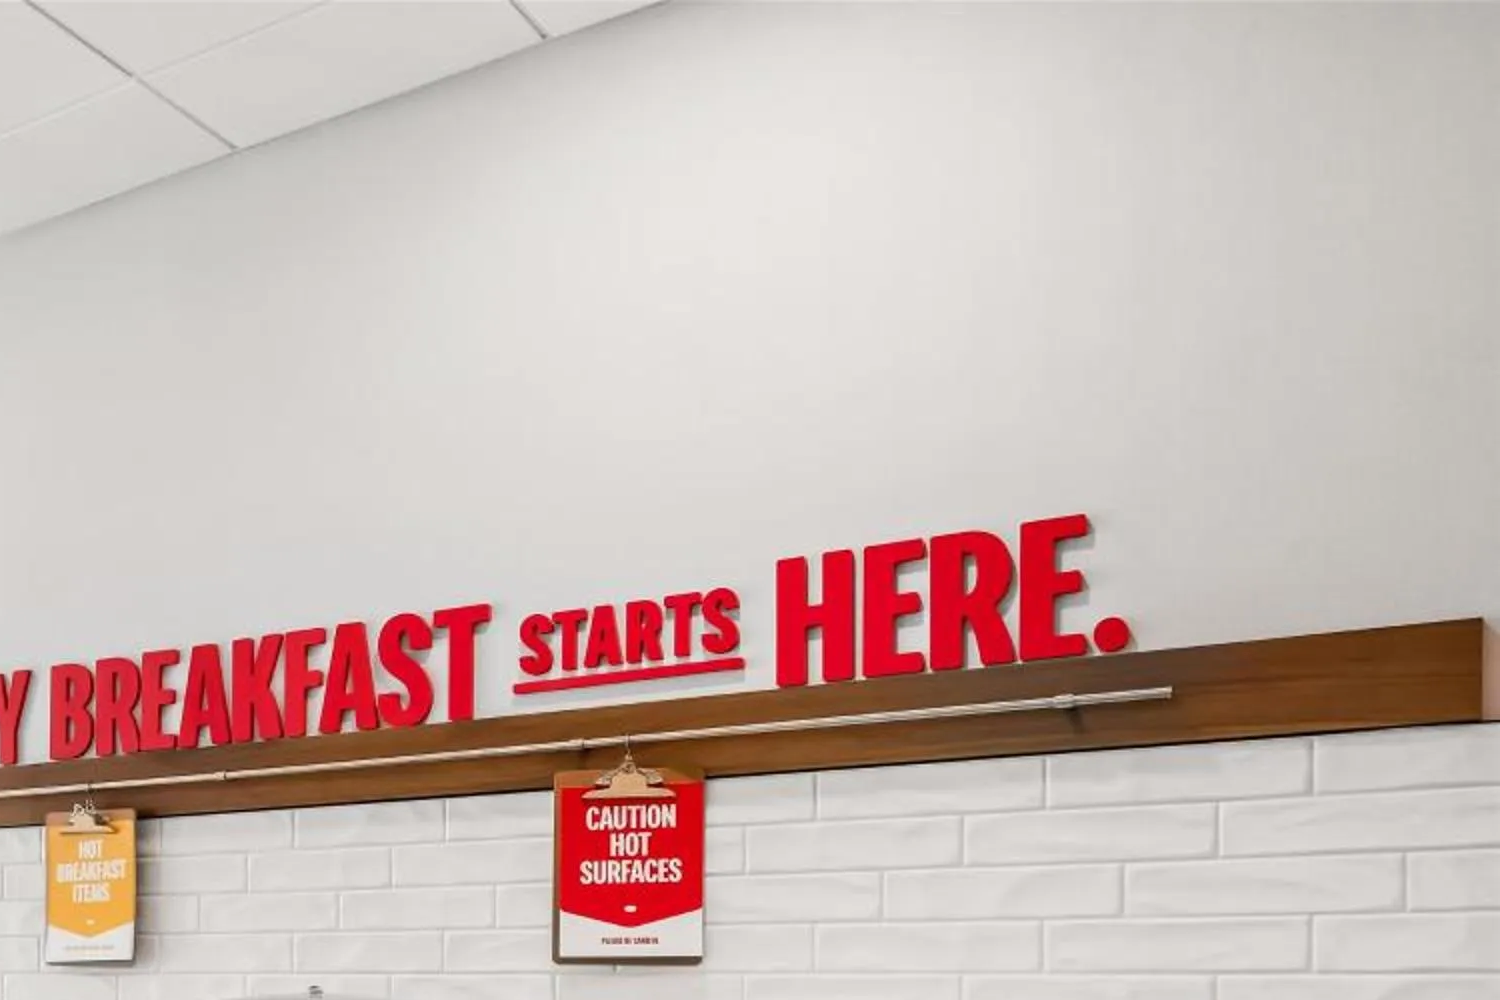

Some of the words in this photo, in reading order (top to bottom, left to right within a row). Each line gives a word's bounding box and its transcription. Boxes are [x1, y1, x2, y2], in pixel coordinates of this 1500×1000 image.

[49, 603, 493, 761] BREAKFAST
[518, 587, 741, 676] STARTS
[775, 513, 1132, 689] HERE.
[585, 804, 677, 831] CAUTION
[78, 839, 104, 860] HOT
[609, 832, 652, 857] HOT
[56, 859, 127, 883] BREAKFAST
[579, 858, 683, 885] SURFACES
[72, 883, 111, 903] ITEMS
